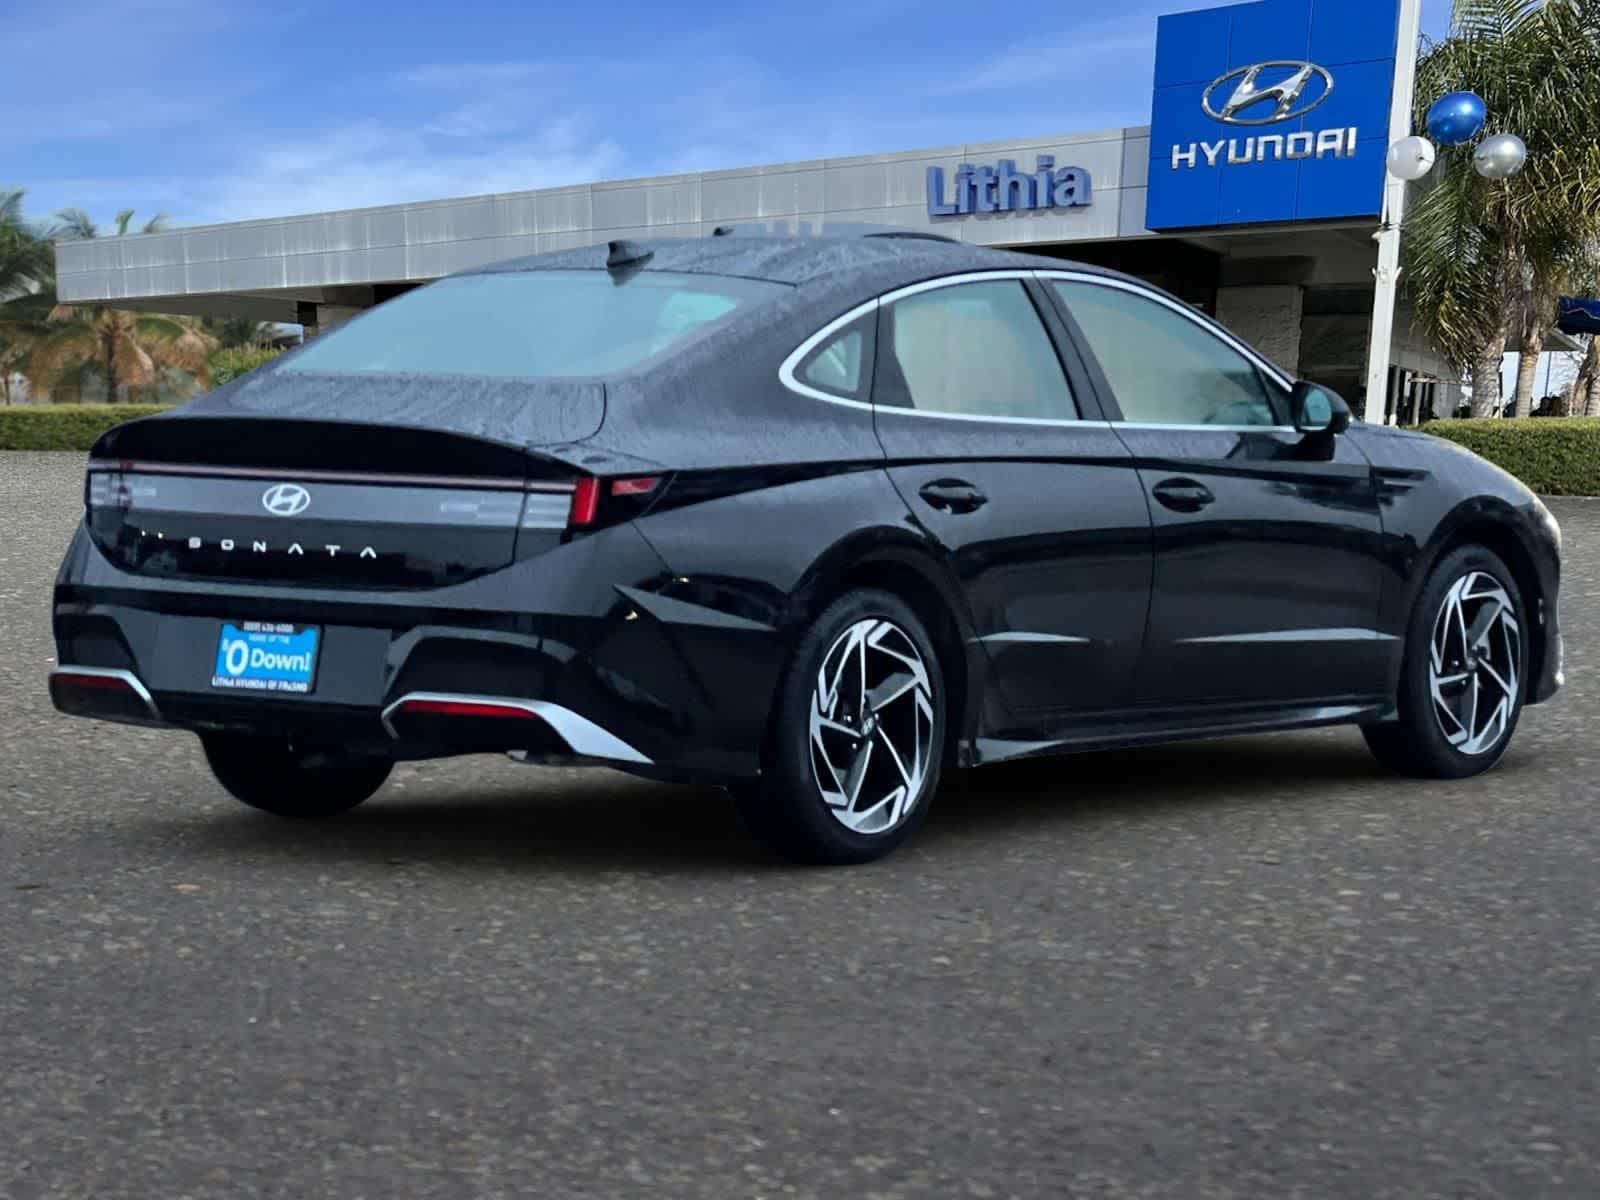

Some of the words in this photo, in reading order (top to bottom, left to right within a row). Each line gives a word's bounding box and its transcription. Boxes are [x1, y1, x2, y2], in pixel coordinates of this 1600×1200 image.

[1171, 127, 1358, 169] HYUNDAI
[926, 155, 1092, 216] Lithia
[188, 537, 377, 559] SONATA
[250, 648, 311, 673] Down!
